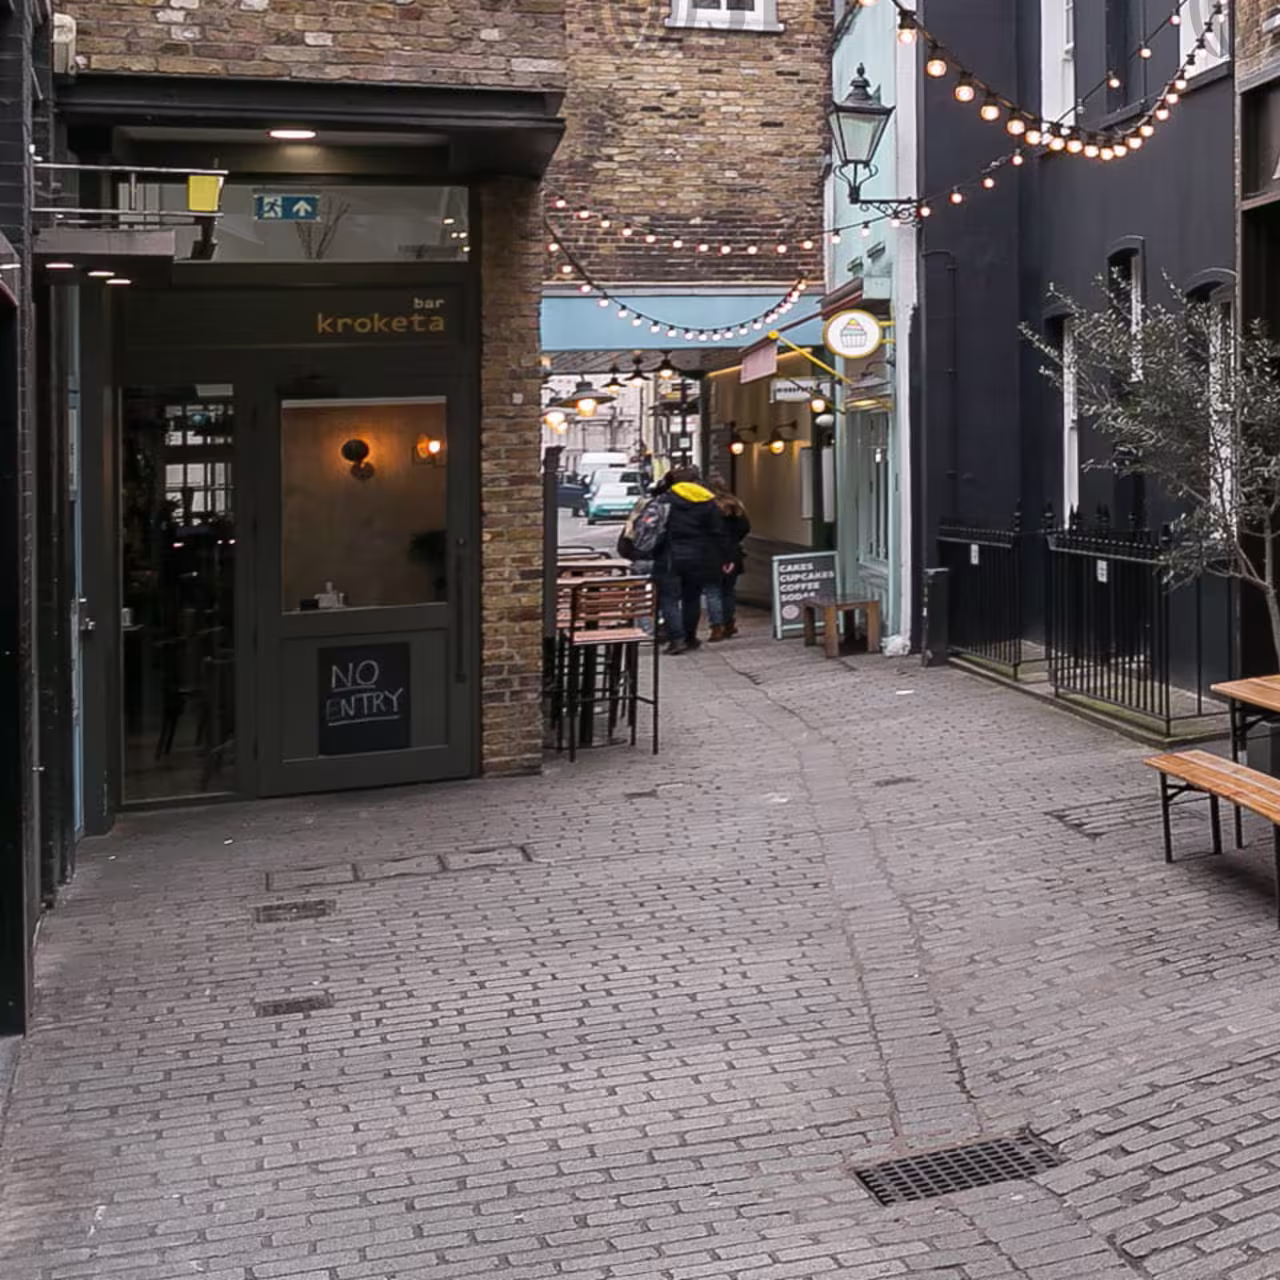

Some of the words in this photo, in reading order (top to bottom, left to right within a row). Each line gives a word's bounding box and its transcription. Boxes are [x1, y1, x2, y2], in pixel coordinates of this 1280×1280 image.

[413, 297, 445, 309] bar
[317, 313, 445, 334] kroketa
[780, 562, 814, 573] CAKES
[780, 570, 834, 583] CUPCAKES
[780, 581, 820, 592] COFFEE
[331, 660, 380, 689] NO
[326, 687, 404, 721] ENTRY
